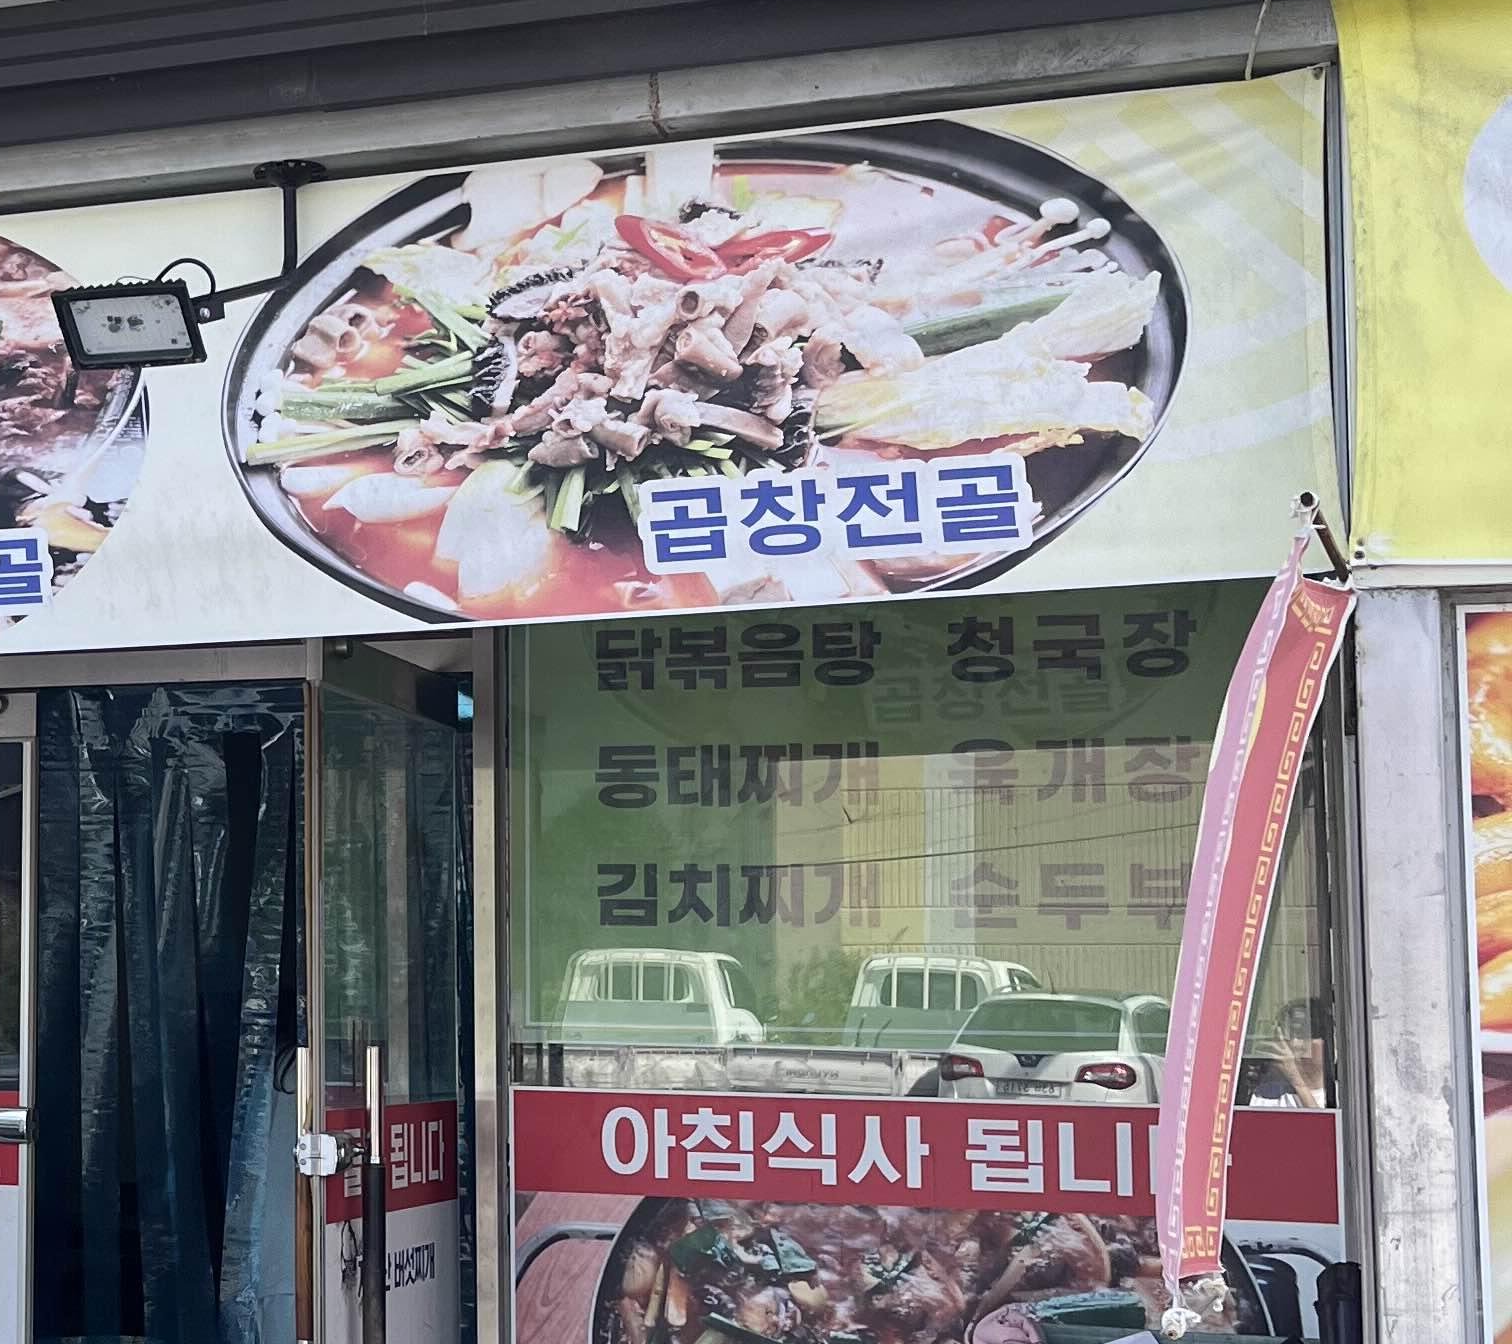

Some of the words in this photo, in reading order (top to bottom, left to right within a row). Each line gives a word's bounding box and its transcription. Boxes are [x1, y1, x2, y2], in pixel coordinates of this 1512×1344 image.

[649, 464, 1020, 563] 곱창전골
[596, 621, 881, 690] 닭볶음탕
[946, 609, 1198, 683] 청국장
[595, 741, 881, 808] 동태찌개
[948, 736, 1201, 804] 육개장
[597, 863, 881, 929] 김치찌개
[951, 862, 1193, 930] 순두부
[390, 1119, 445, 1190] 됩니다
[600, 1105, 929, 1189] 아침식사
[966, 1118, 1232, 1197] 됩니
